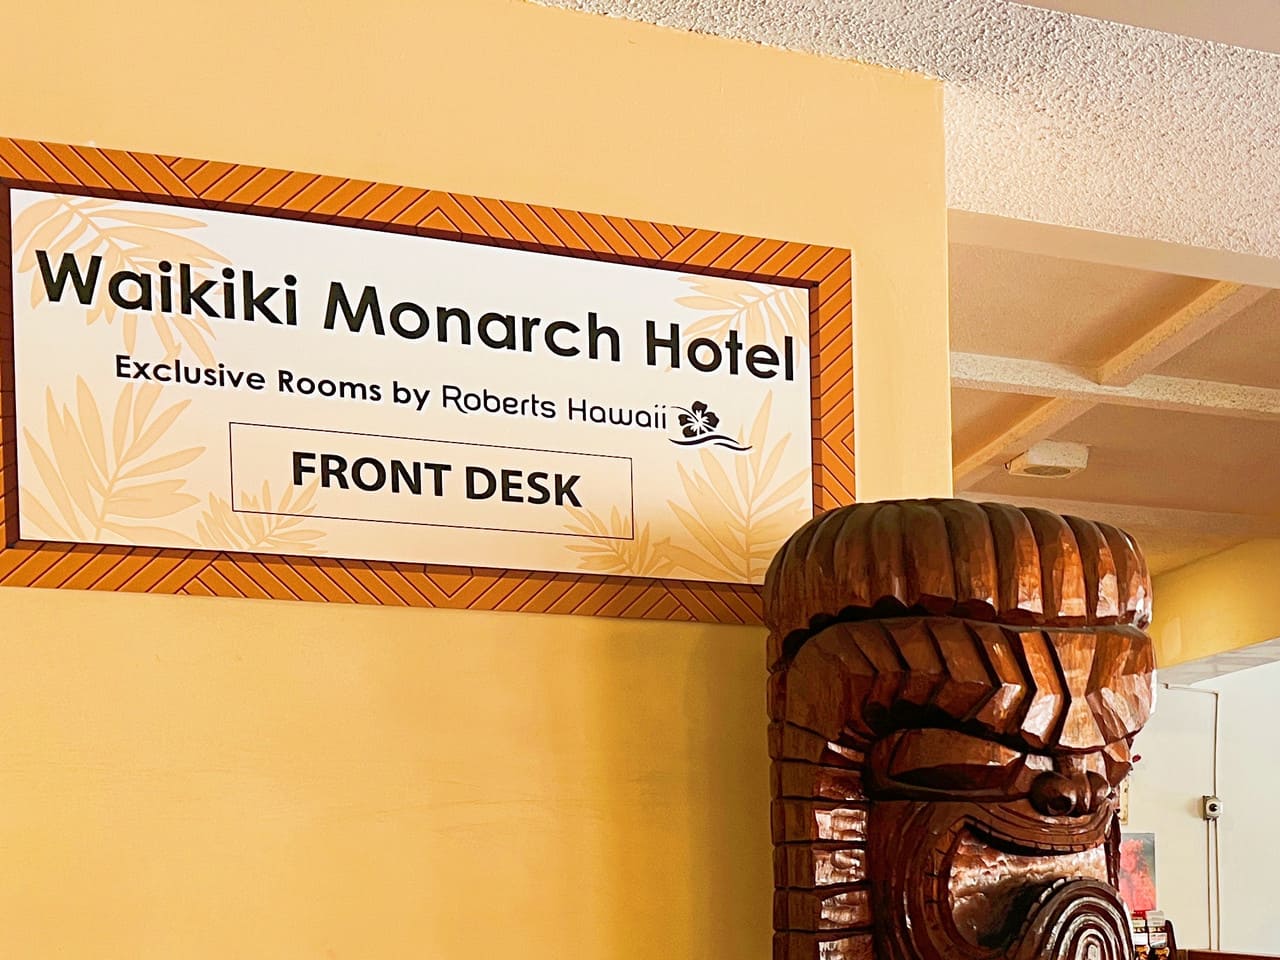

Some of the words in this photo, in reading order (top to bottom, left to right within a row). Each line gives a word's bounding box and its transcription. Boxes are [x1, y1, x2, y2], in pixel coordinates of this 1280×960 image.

[36, 250, 298, 326] Waikiki
[324, 282, 621, 362] Monarch
[646, 320, 794, 382] Hotel
[116, 355, 266, 392] Exclusive
[279, 370, 382, 403] Rooms
[393, 381, 431, 412] by
[443, 385, 556, 420] Roberts
[569, 398, 667, 430] Hawaii
[293, 452, 452, 497] FRONT
[466, 469, 583, 508] DESK
